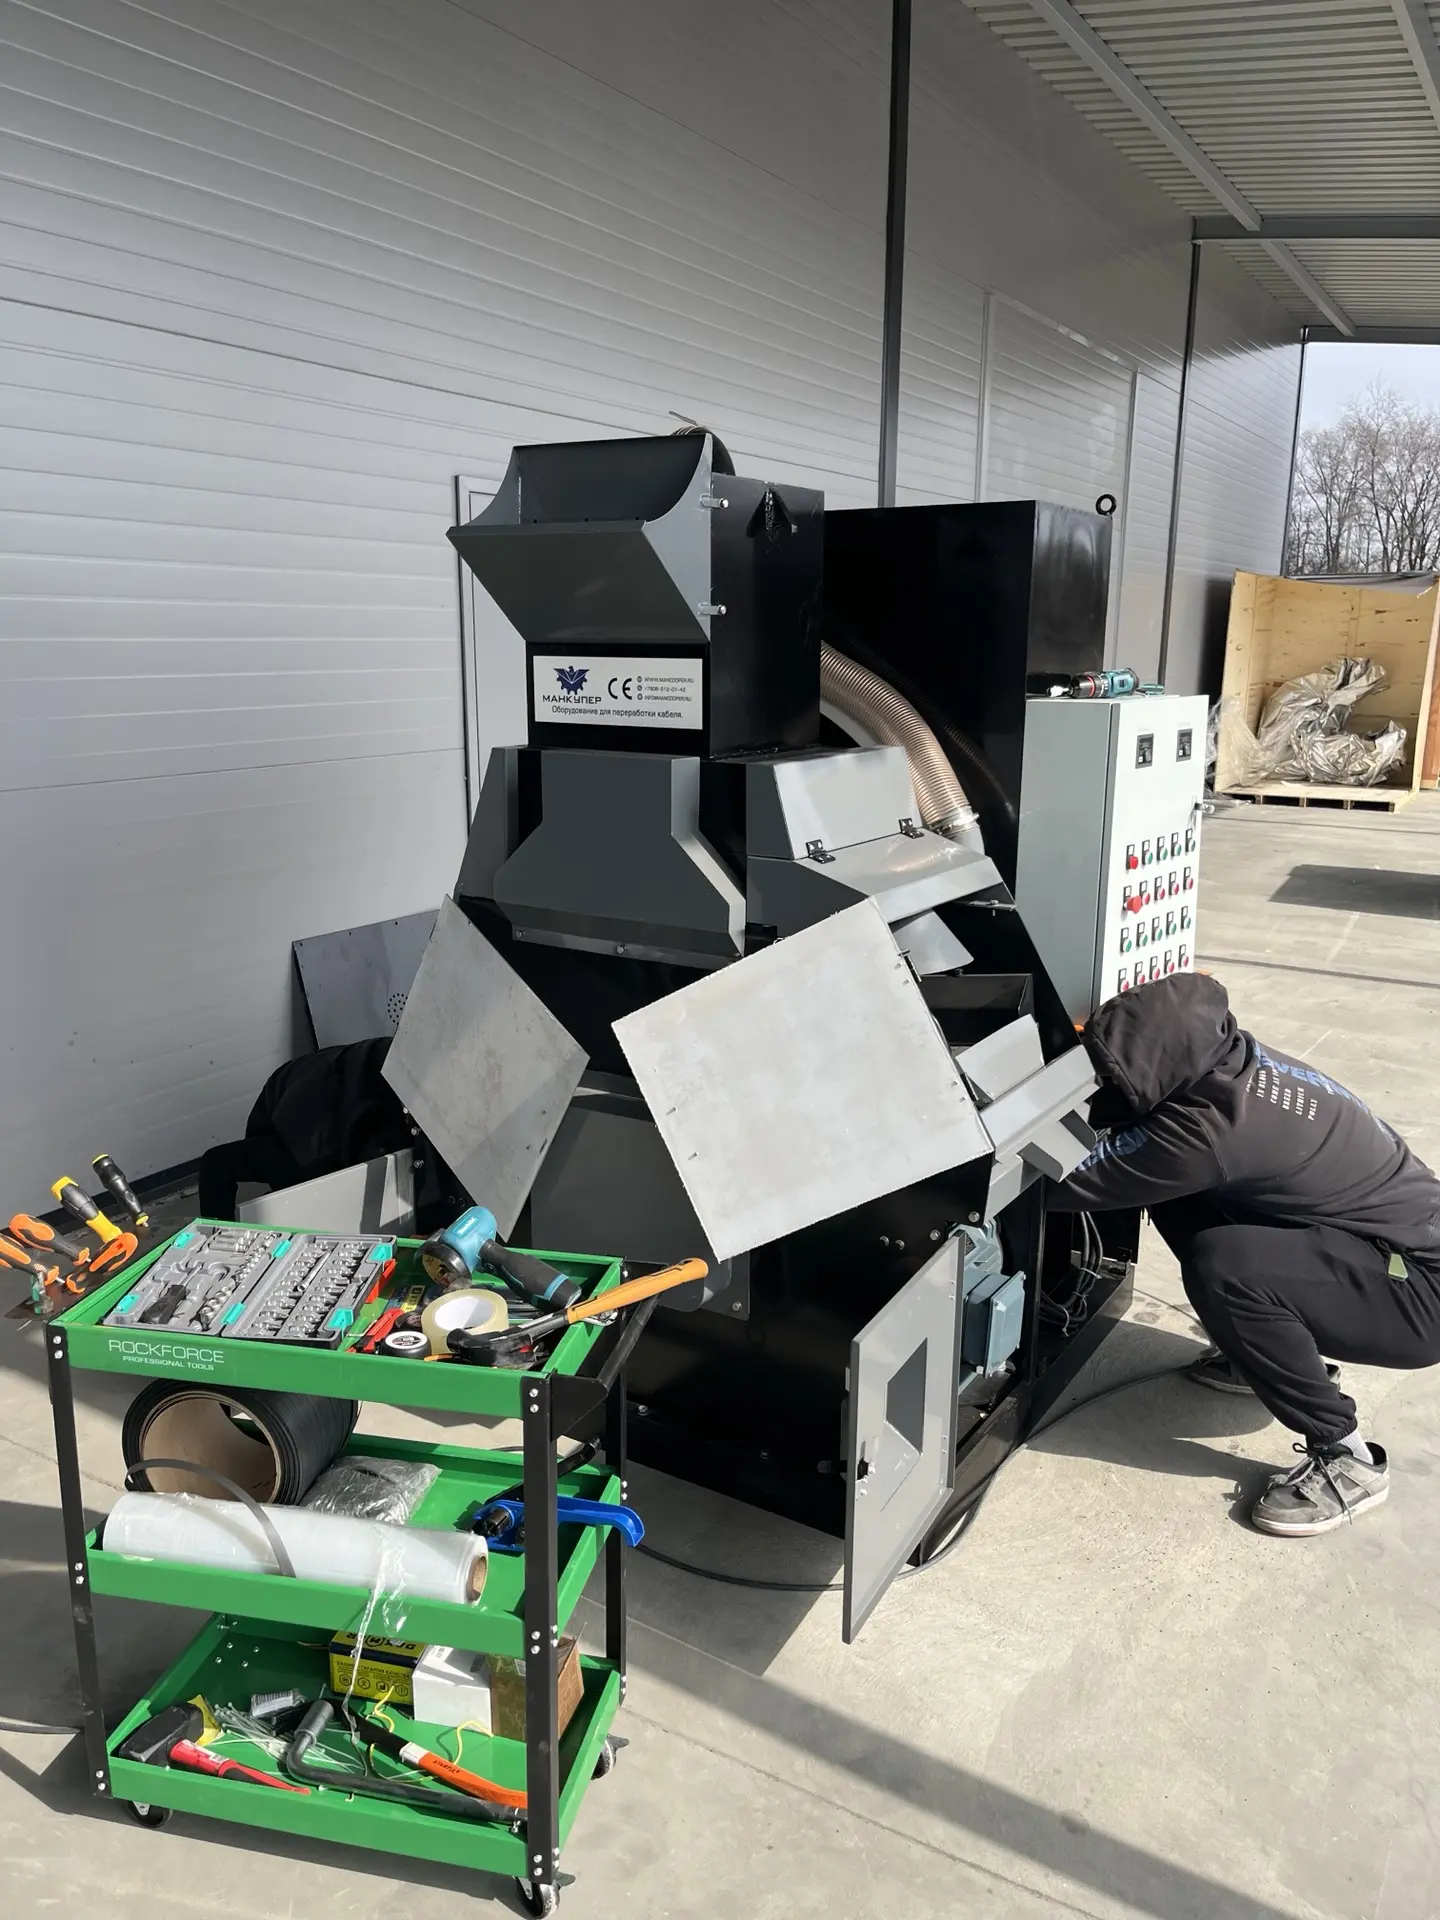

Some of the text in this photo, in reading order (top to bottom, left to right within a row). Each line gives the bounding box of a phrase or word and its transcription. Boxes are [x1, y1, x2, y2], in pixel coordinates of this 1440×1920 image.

[608, 677, 632, 700] CE
[542, 695, 602, 705] МАНКУПЕР
[552, 705, 683, 718] Оборудование для переработки кабеля.
[108, 1339, 224, 1363] ROCKFORCE
[122, 1355, 214, 1371] PROFESSIONAL TOOLS
